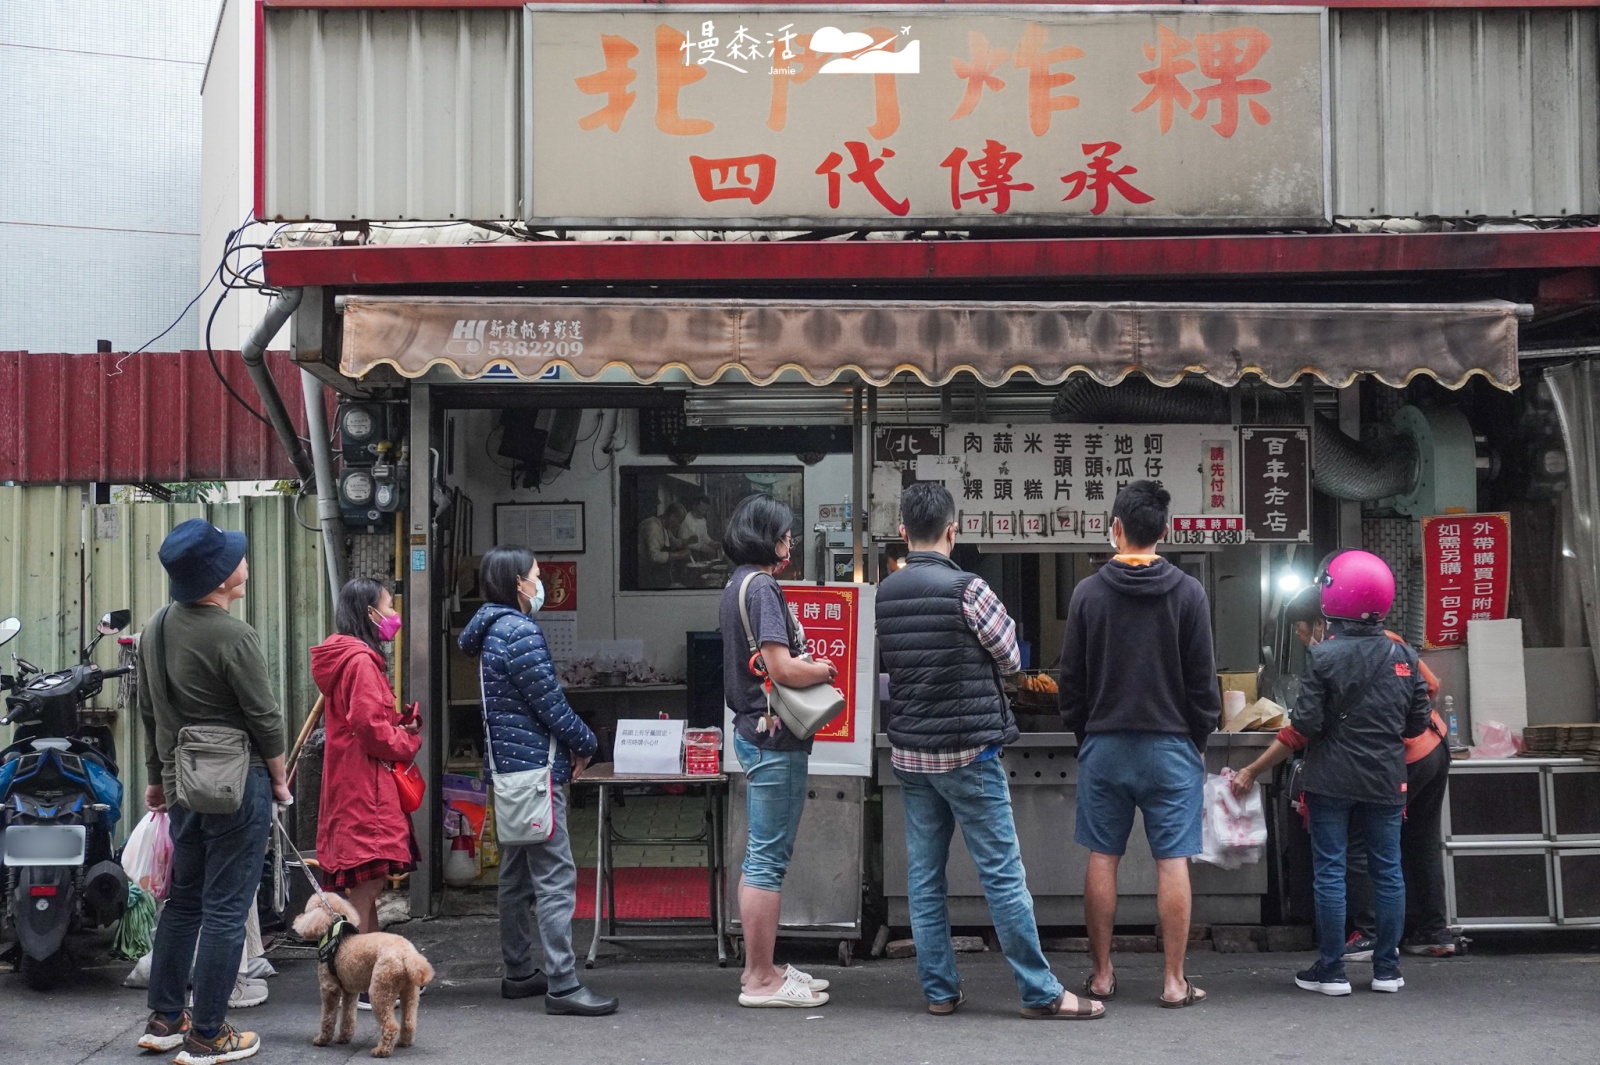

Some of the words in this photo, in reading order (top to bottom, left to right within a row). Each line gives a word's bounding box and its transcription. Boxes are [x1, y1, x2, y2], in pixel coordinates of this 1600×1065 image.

[688, 140, 1155, 216] 四代傳承
[488, 340, 584, 357] 5382209
[1023, 432, 1044, 500] 米糕
[1053, 432, 1073, 500] 芋頭片
[1084, 433, 1104, 500] 芋頭糕
[1143, 433, 1164, 489] 蚵仔
[1210, 446, 1225, 508] 請先付款
[1262, 437, 1290, 532] 百年老店
[966, 519, 980, 530] 17
[996, 519, 1009, 530] 12
[1026, 519, 1040, 530] 12
[1088, 518, 1101, 529] 12
[1180, 519, 1237, 530] 營業時間
[1437, 524, 1462, 642] 如需另購，一包5元
